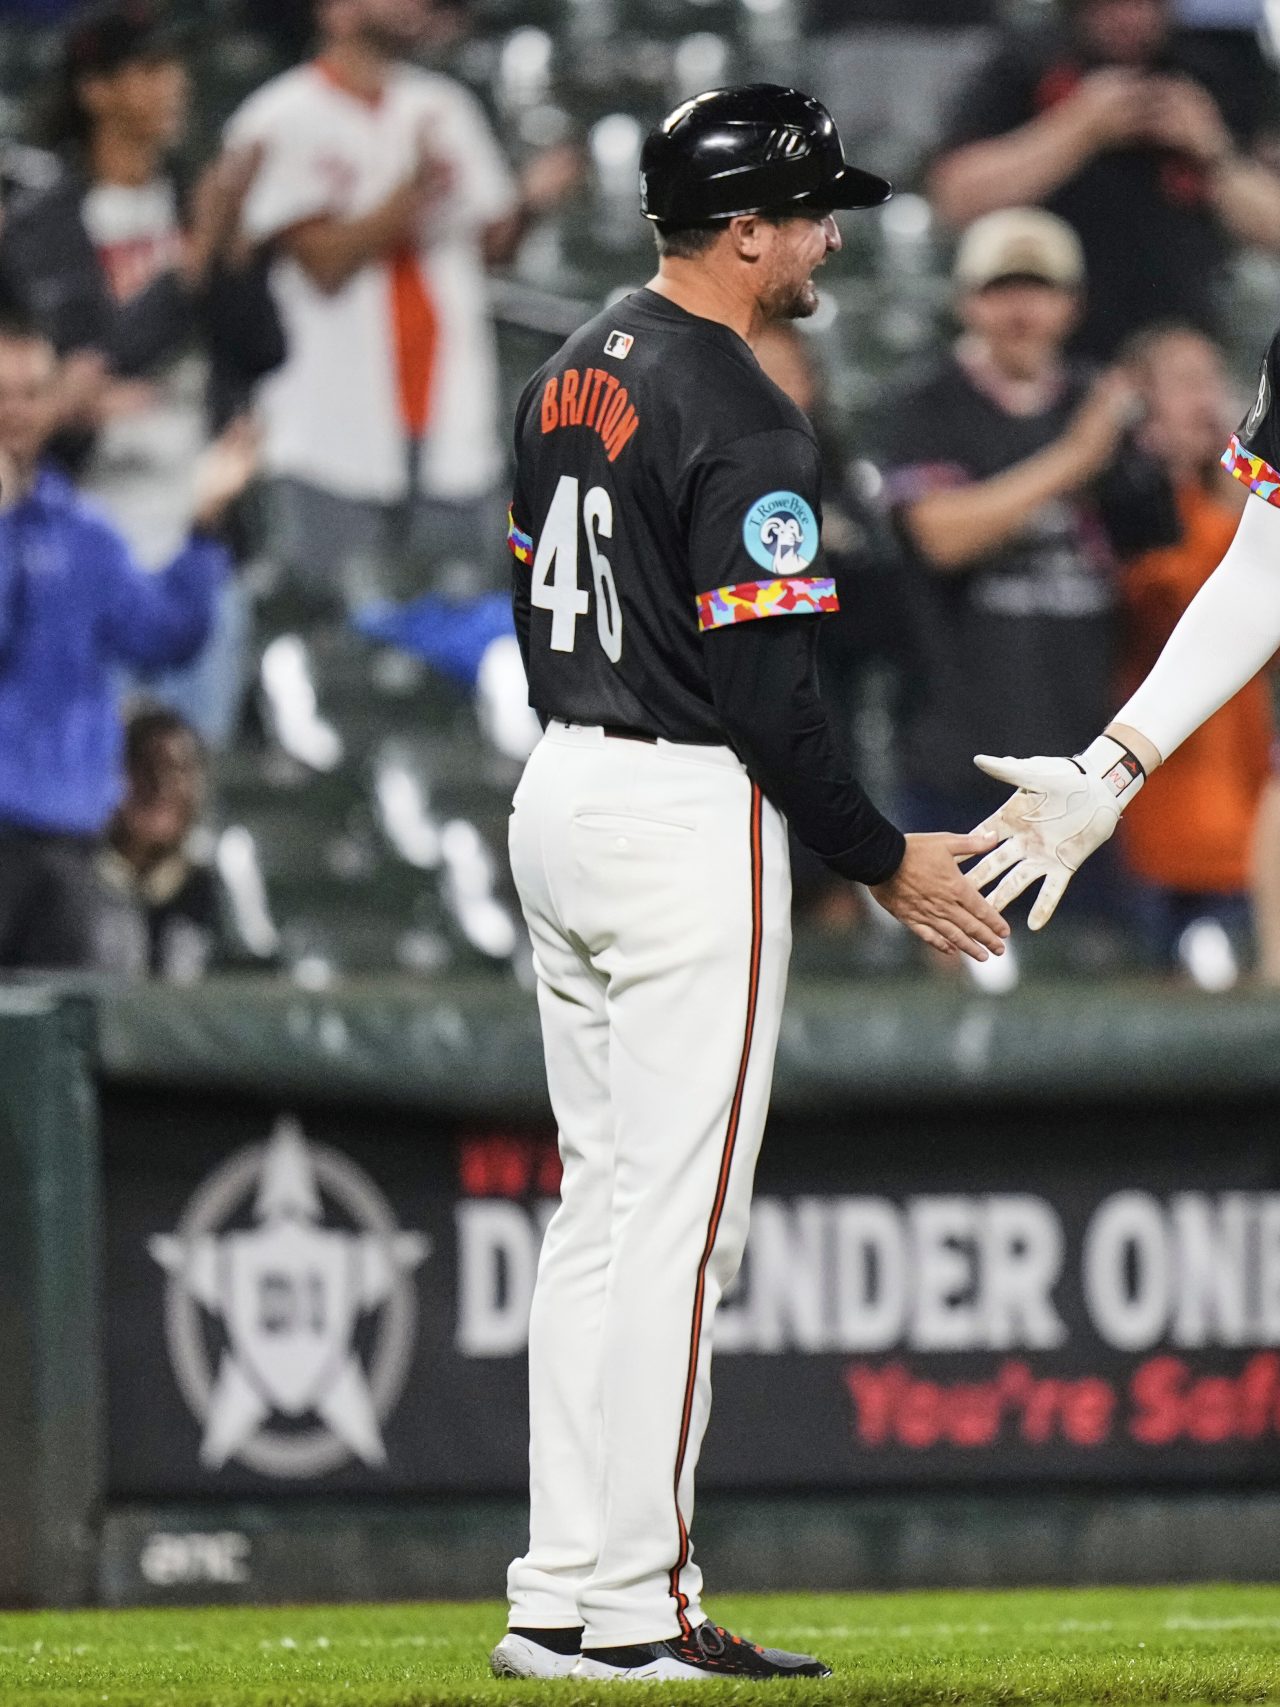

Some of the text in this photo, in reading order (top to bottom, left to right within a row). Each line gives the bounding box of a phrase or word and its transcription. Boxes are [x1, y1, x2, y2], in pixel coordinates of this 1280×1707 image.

[541, 368, 639, 462] BRITTON
[531, 475, 622, 663] 46
[457, 1195, 1066, 1353] DNDER
[846, 1361, 1113, 1446] You're
